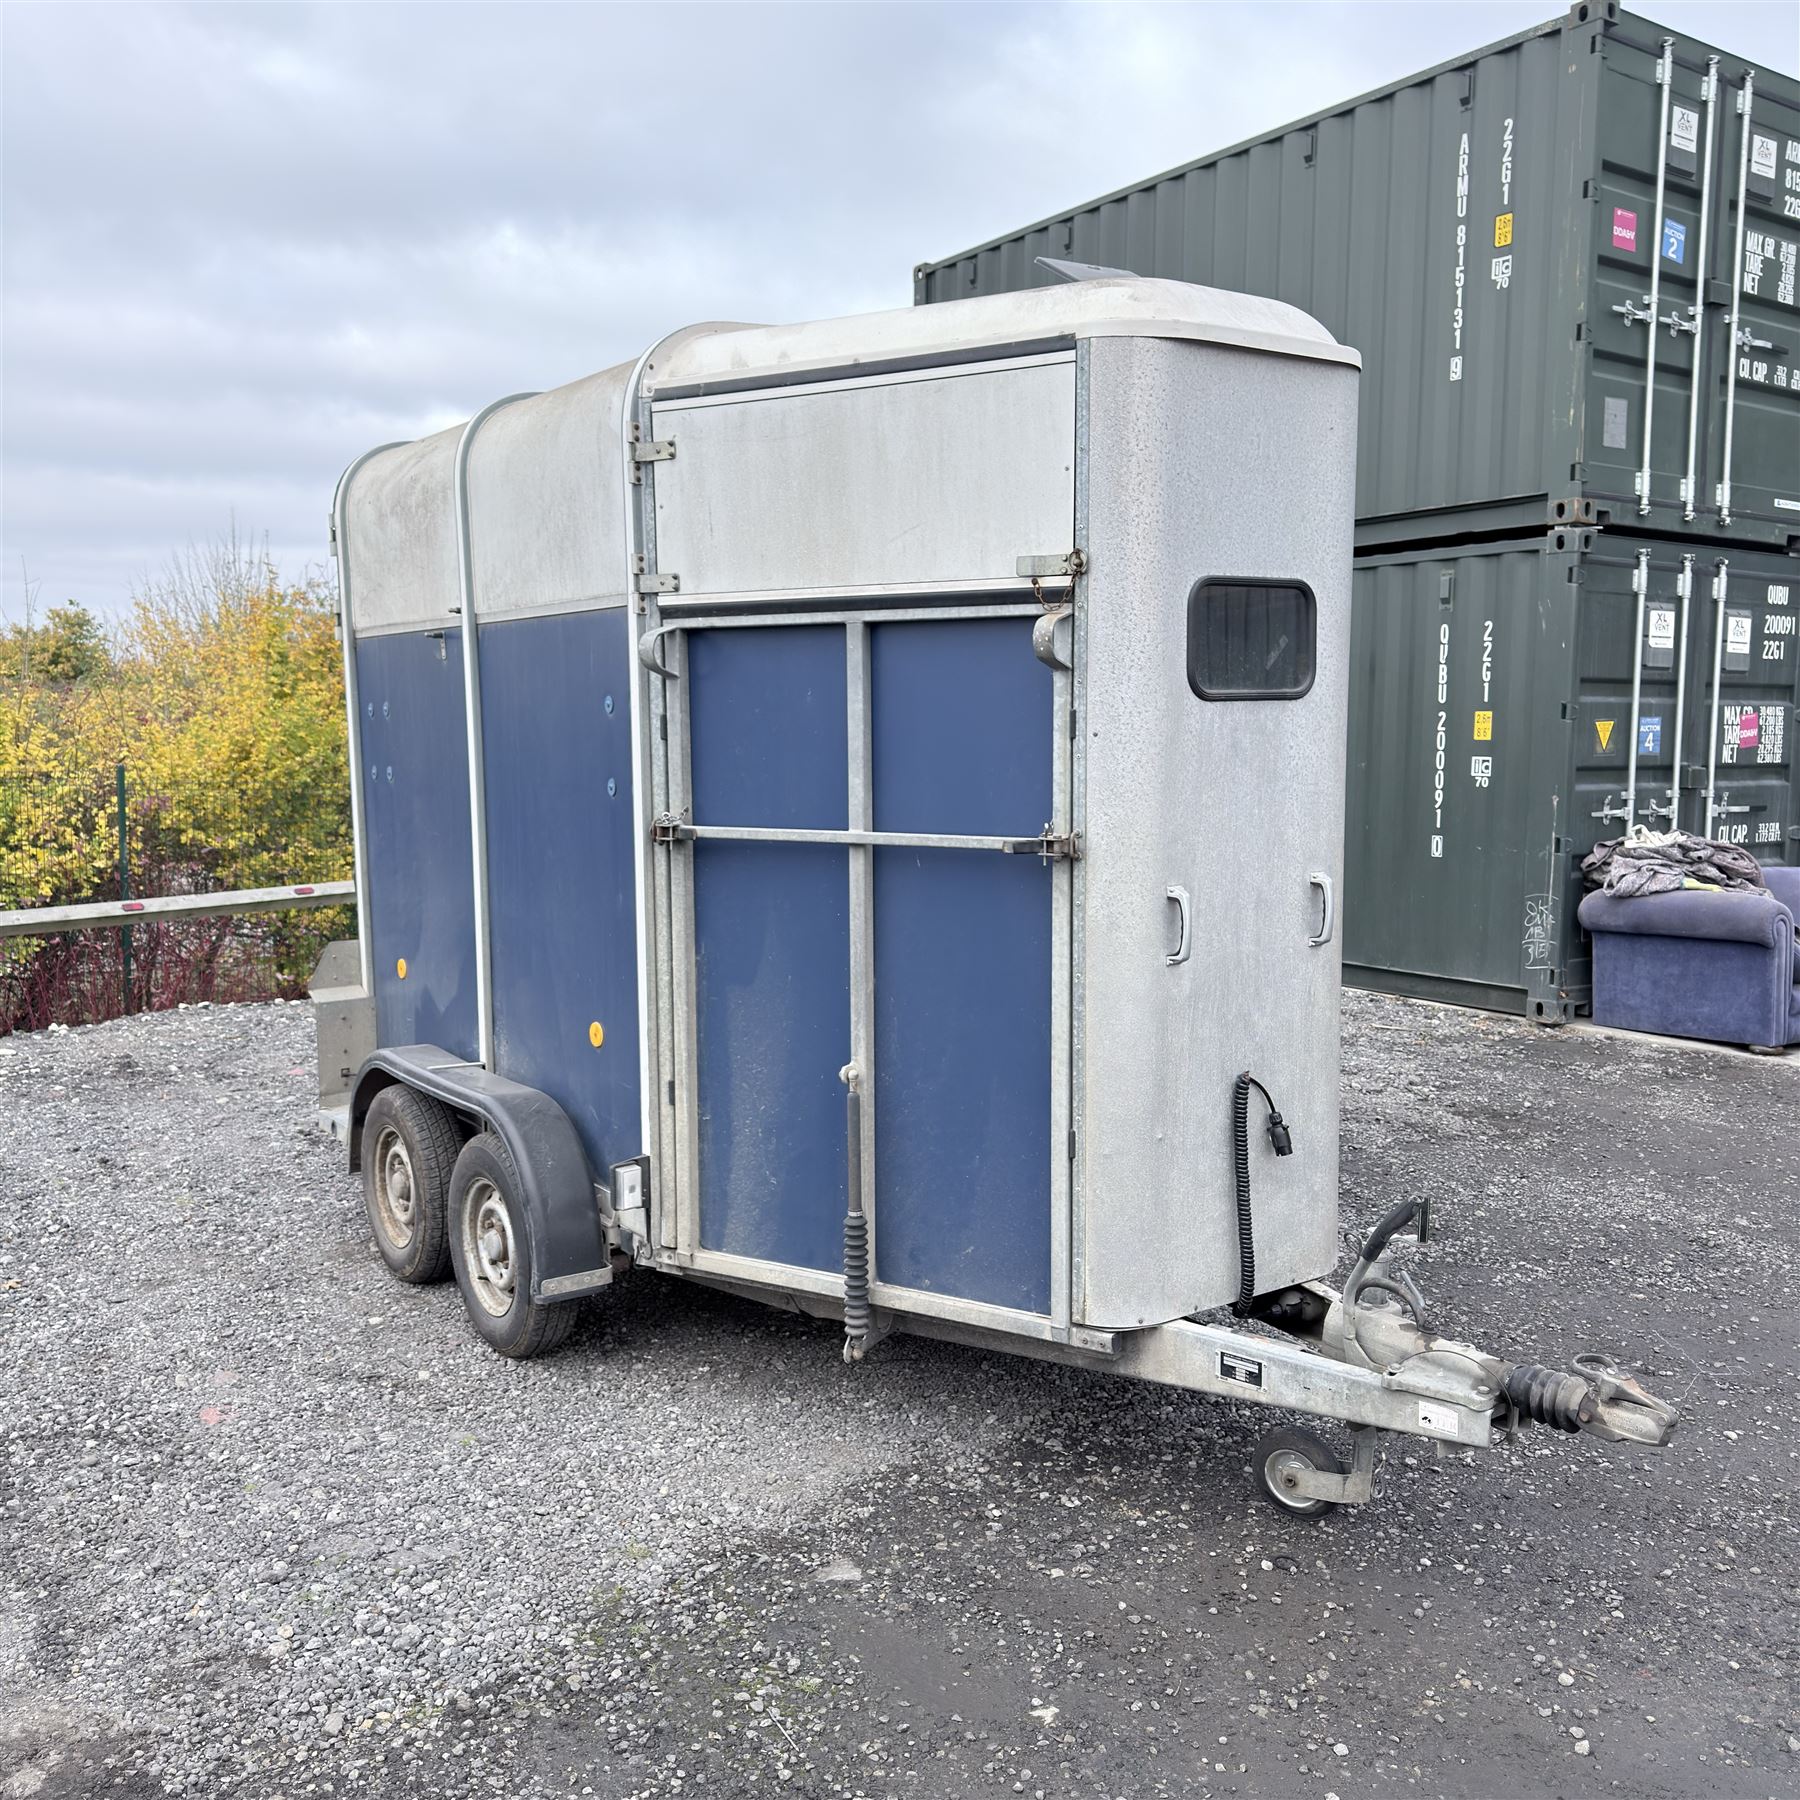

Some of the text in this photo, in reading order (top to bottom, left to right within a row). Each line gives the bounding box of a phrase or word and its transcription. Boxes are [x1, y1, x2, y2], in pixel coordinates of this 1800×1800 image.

[1679, 110, 1691, 123] XL
[1759, 139, 1770, 151] XL
[1501, 118, 1513, 205] 22G1
[1668, 237, 1677, 259] 2
[1745, 230, 1764, 255] MAX
[1451, 133, 1469, 380] ARMU 815131 9
[1745, 251, 1764, 276] TARE
[1496, 278, 1509, 290] 70
[1743, 271, 1760, 295] NET
[1767, 585, 1789, 606] QUBU
[1656, 612, 1667, 623] XL
[1735, 619, 1744, 629] XL
[1763, 614, 1796, 635] 200091
[1762, 640, 1785, 660] 22G1
[1438, 623, 1449, 704] QUBU
[1482, 620, 1494, 703] 22G1
[1724, 706, 1740, 724] MAX
[1644, 732, 1654, 752] 4
[1722, 744, 1738, 763] NET
[1434, 711, 1447, 828] 200091
[1474, 776, 1489, 788] 70
[1731, 824, 1748, 843] CAP.
